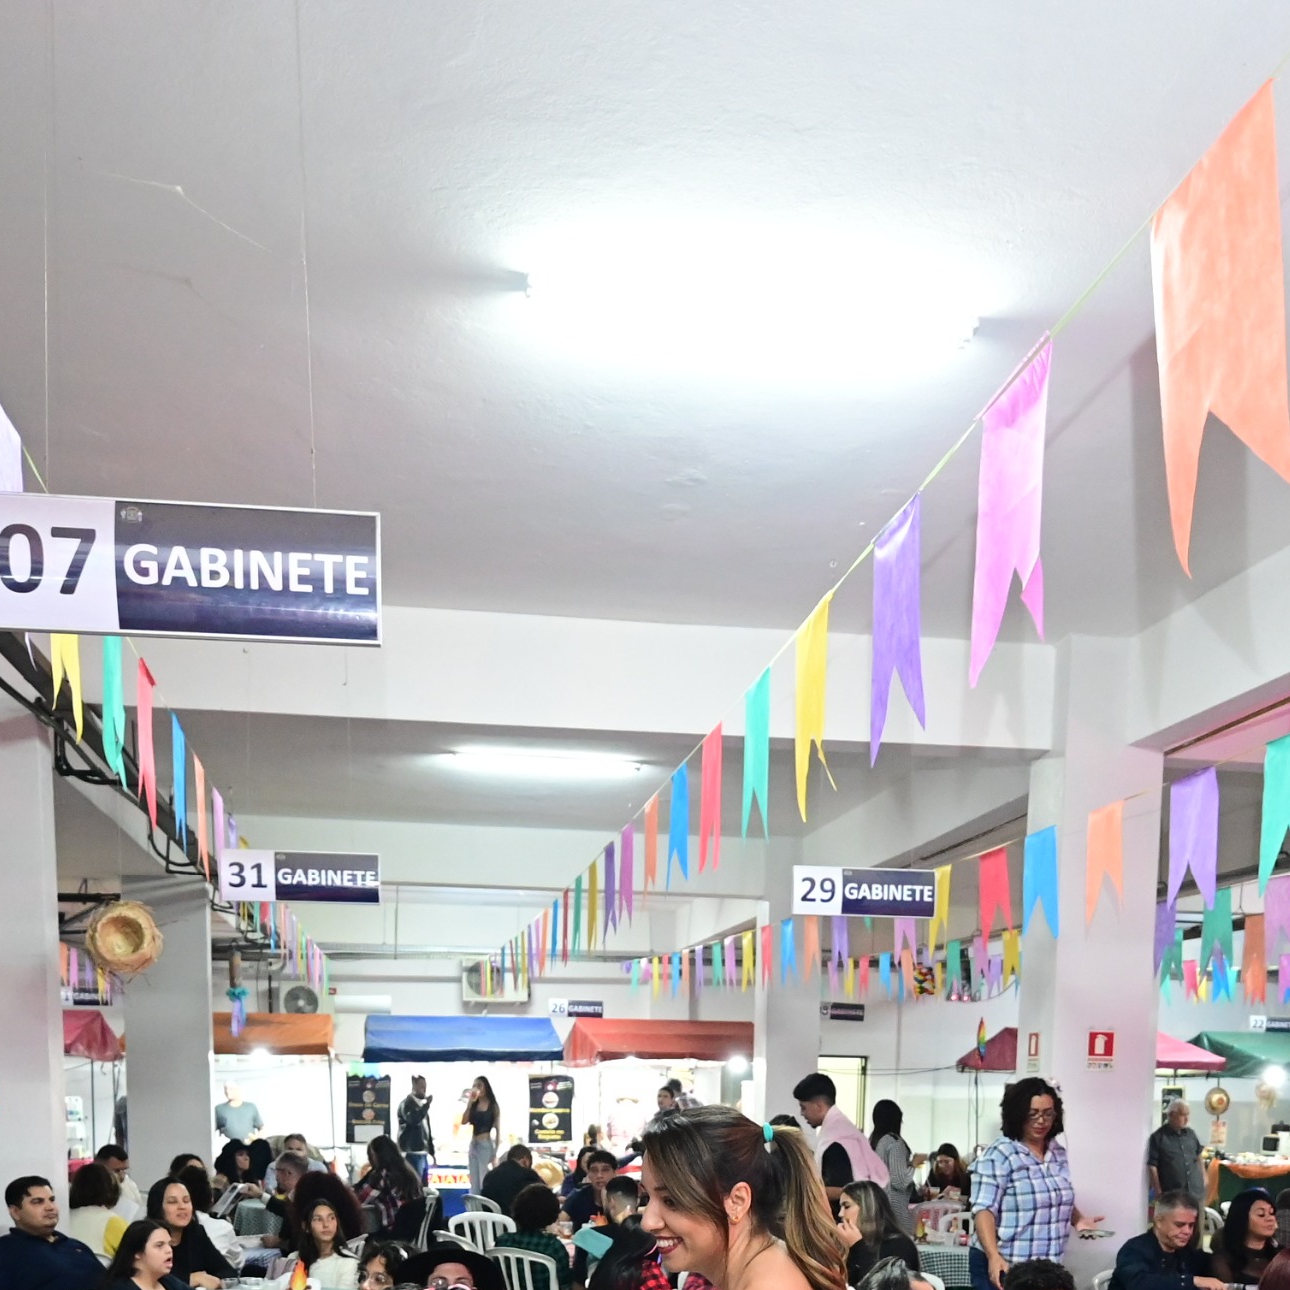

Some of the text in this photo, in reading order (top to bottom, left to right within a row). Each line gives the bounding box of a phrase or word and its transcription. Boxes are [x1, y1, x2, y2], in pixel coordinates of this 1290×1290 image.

[123, 543, 370, 596] GABINETE
[227, 861, 377, 889] 31 GABINETE
[800, 876, 934, 903] 29 GABINETE
[551, 1002, 603, 1014] 26 GABINETE
[1252, 1019, 1265, 1029] 22
